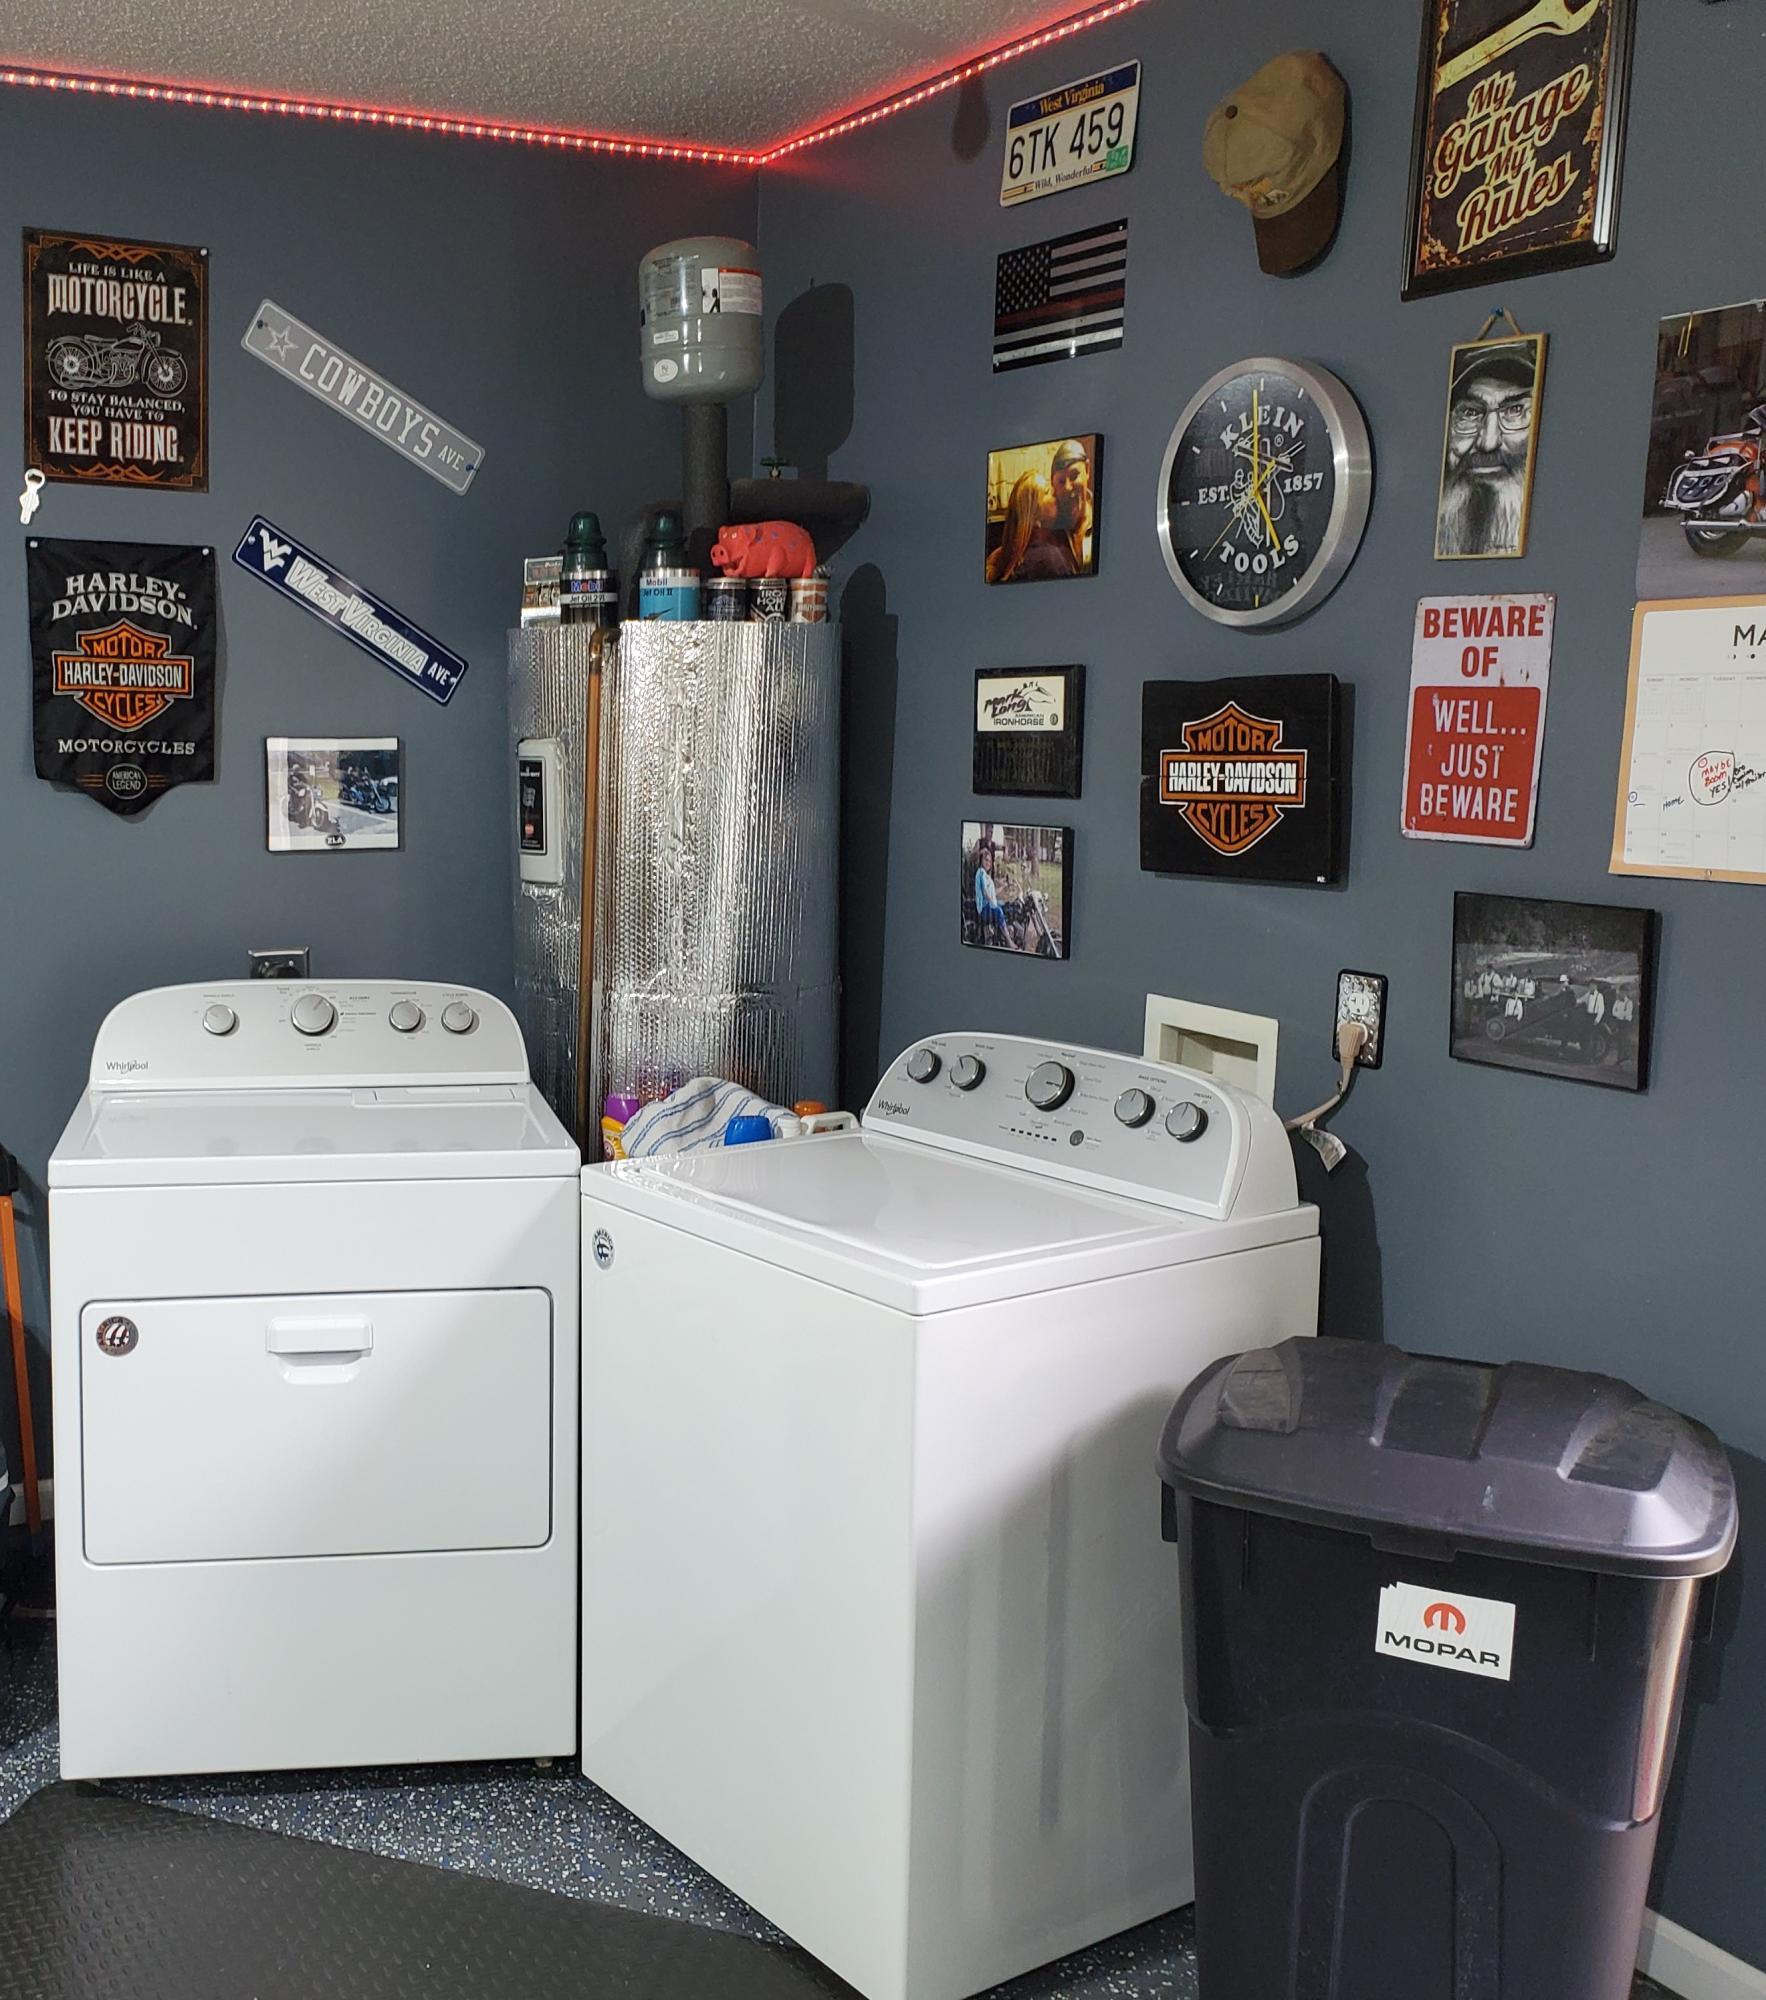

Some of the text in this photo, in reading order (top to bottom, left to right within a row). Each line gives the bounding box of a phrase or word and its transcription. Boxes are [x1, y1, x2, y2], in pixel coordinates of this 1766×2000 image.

[1040, 81, 1104, 115] West Virginia
[1468, 70, 1515, 119] My
[1009, 122, 1060, 179] 6TK
[1069, 102, 1125, 159] 459
[1434, 63, 1592, 198] Garage
[1055, 165, 1093, 185] Wonderful
[1486, 139, 1535, 186] My
[1456, 151, 1580, 253] Rules
[68, 262, 166, 283] LIFE IS LIKE A
[47, 273, 193, 326] MOTORCYCLE.
[48, 389, 186, 413] TO STAY BALANCED,
[71, 404, 164, 421] YOU HAVE TO
[299, 343, 464, 471] COWBOYS AVE
[47, 416, 185, 464] KEEP RIDING.
[1219, 404, 1305, 450] KLEIN
[1198, 472, 1324, 505] EST. 1857
[1219, 534, 1300, 575] TOOLS
[65, 571, 186, 600] HARLEY-
[571, 581, 603, 593] Mobil
[646, 578, 668, 586] Mobil
[653, 588, 665, 596] Oil
[284, 555, 346, 616] WEST
[340, 594, 429, 676] VIRGINIA
[427, 661, 451, 686] AVE
[1423, 604, 1546, 639] BEWARE
[93, 632, 155, 657] MOTOR
[64, 661, 183, 689] HARLEY-DAVIDSON
[1461, 646, 1499, 677] OF
[94, 692, 158, 722] CYCLES
[993, 718, 1045, 726] IRONHORSE
[1434, 699, 1527, 736] WELL...
[57, 738, 196, 756] MOTORCYCLES
[1197, 716, 1265, 752] MOTOR
[112, 770, 142, 780] AMERICAN
[1440, 743, 1504, 779] JUST
[112, 780, 142, 790] LEGEND
[1168, 762, 1297, 795] HARLEY-DAVIDSON
[1420, 783, 1518, 823] BEWARE
[1197, 802, 1264, 844] CYCLES
[106, 1060, 149, 1074] Whirlpool
[878, 1099, 911, 1116] Whirlpool
[1384, 1631, 1500, 1667] MOPAR
